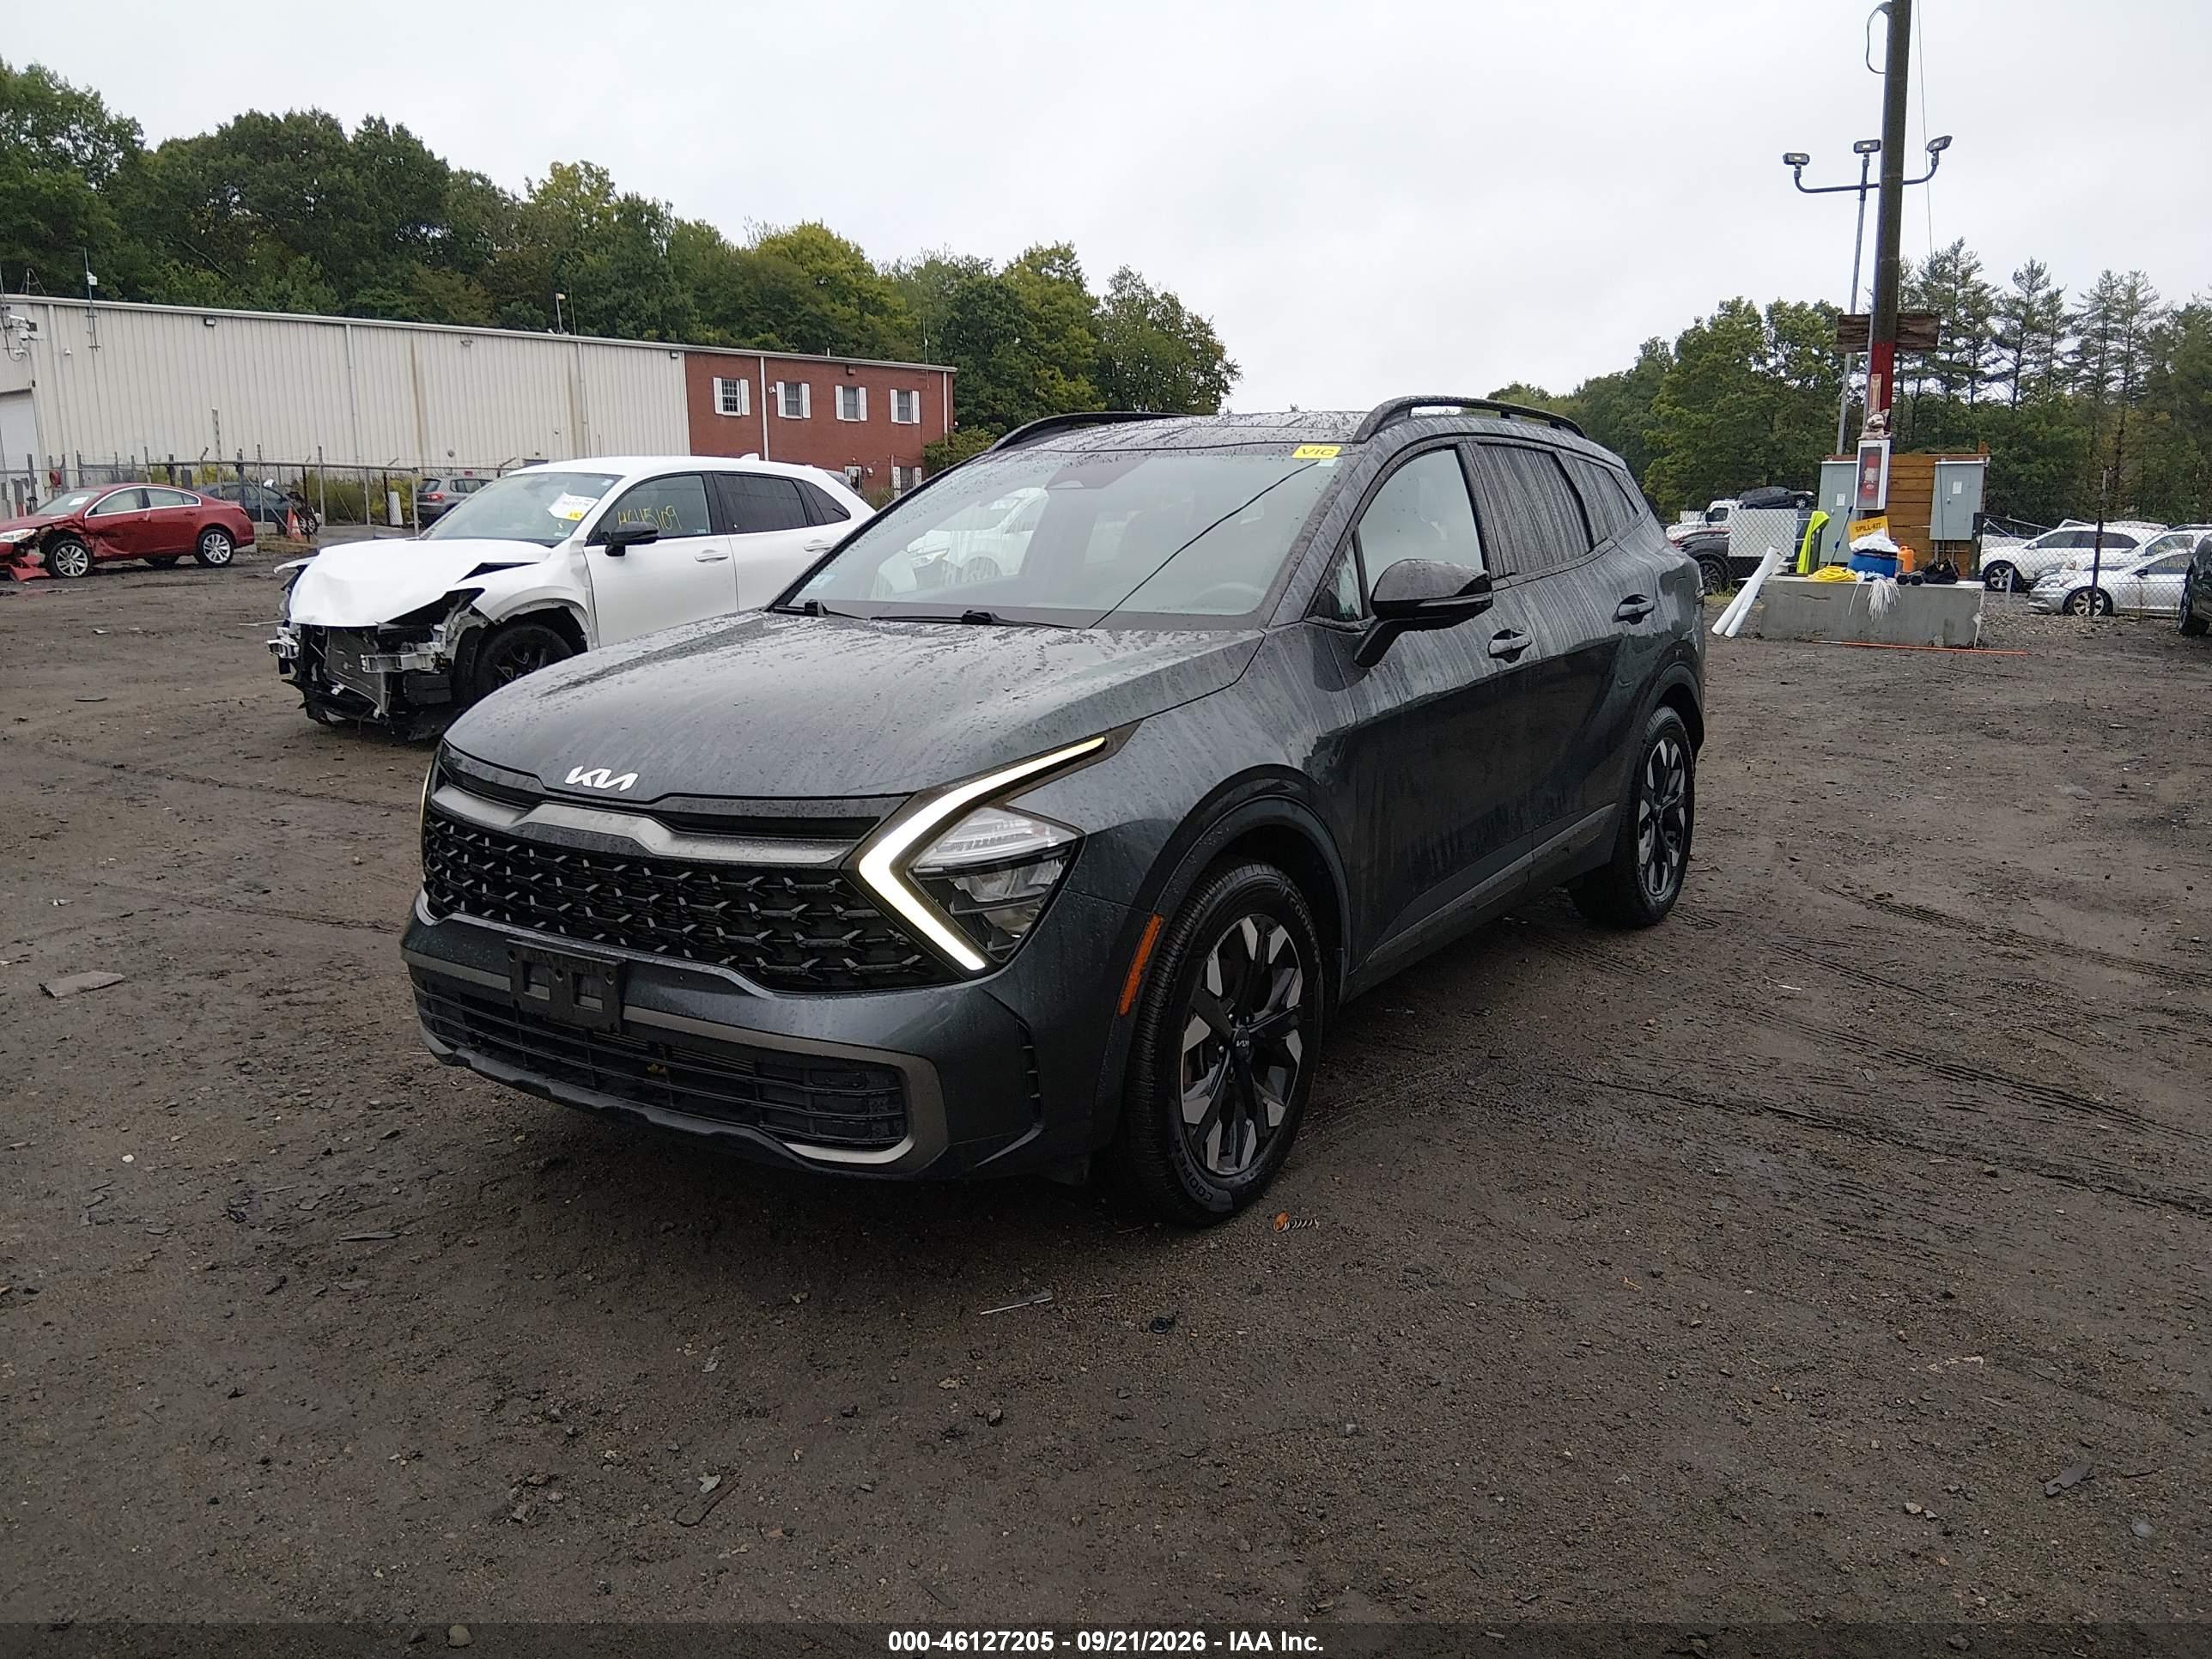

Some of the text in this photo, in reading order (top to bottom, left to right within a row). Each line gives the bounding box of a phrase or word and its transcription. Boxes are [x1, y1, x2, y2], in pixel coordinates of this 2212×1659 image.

[1300, 447, 1336, 456] VIC
[1855, 522, 1881, 532] SPILL-KIT
[564, 765, 639, 792] KIA
[1174, 1139, 1213, 1202] COOPER
